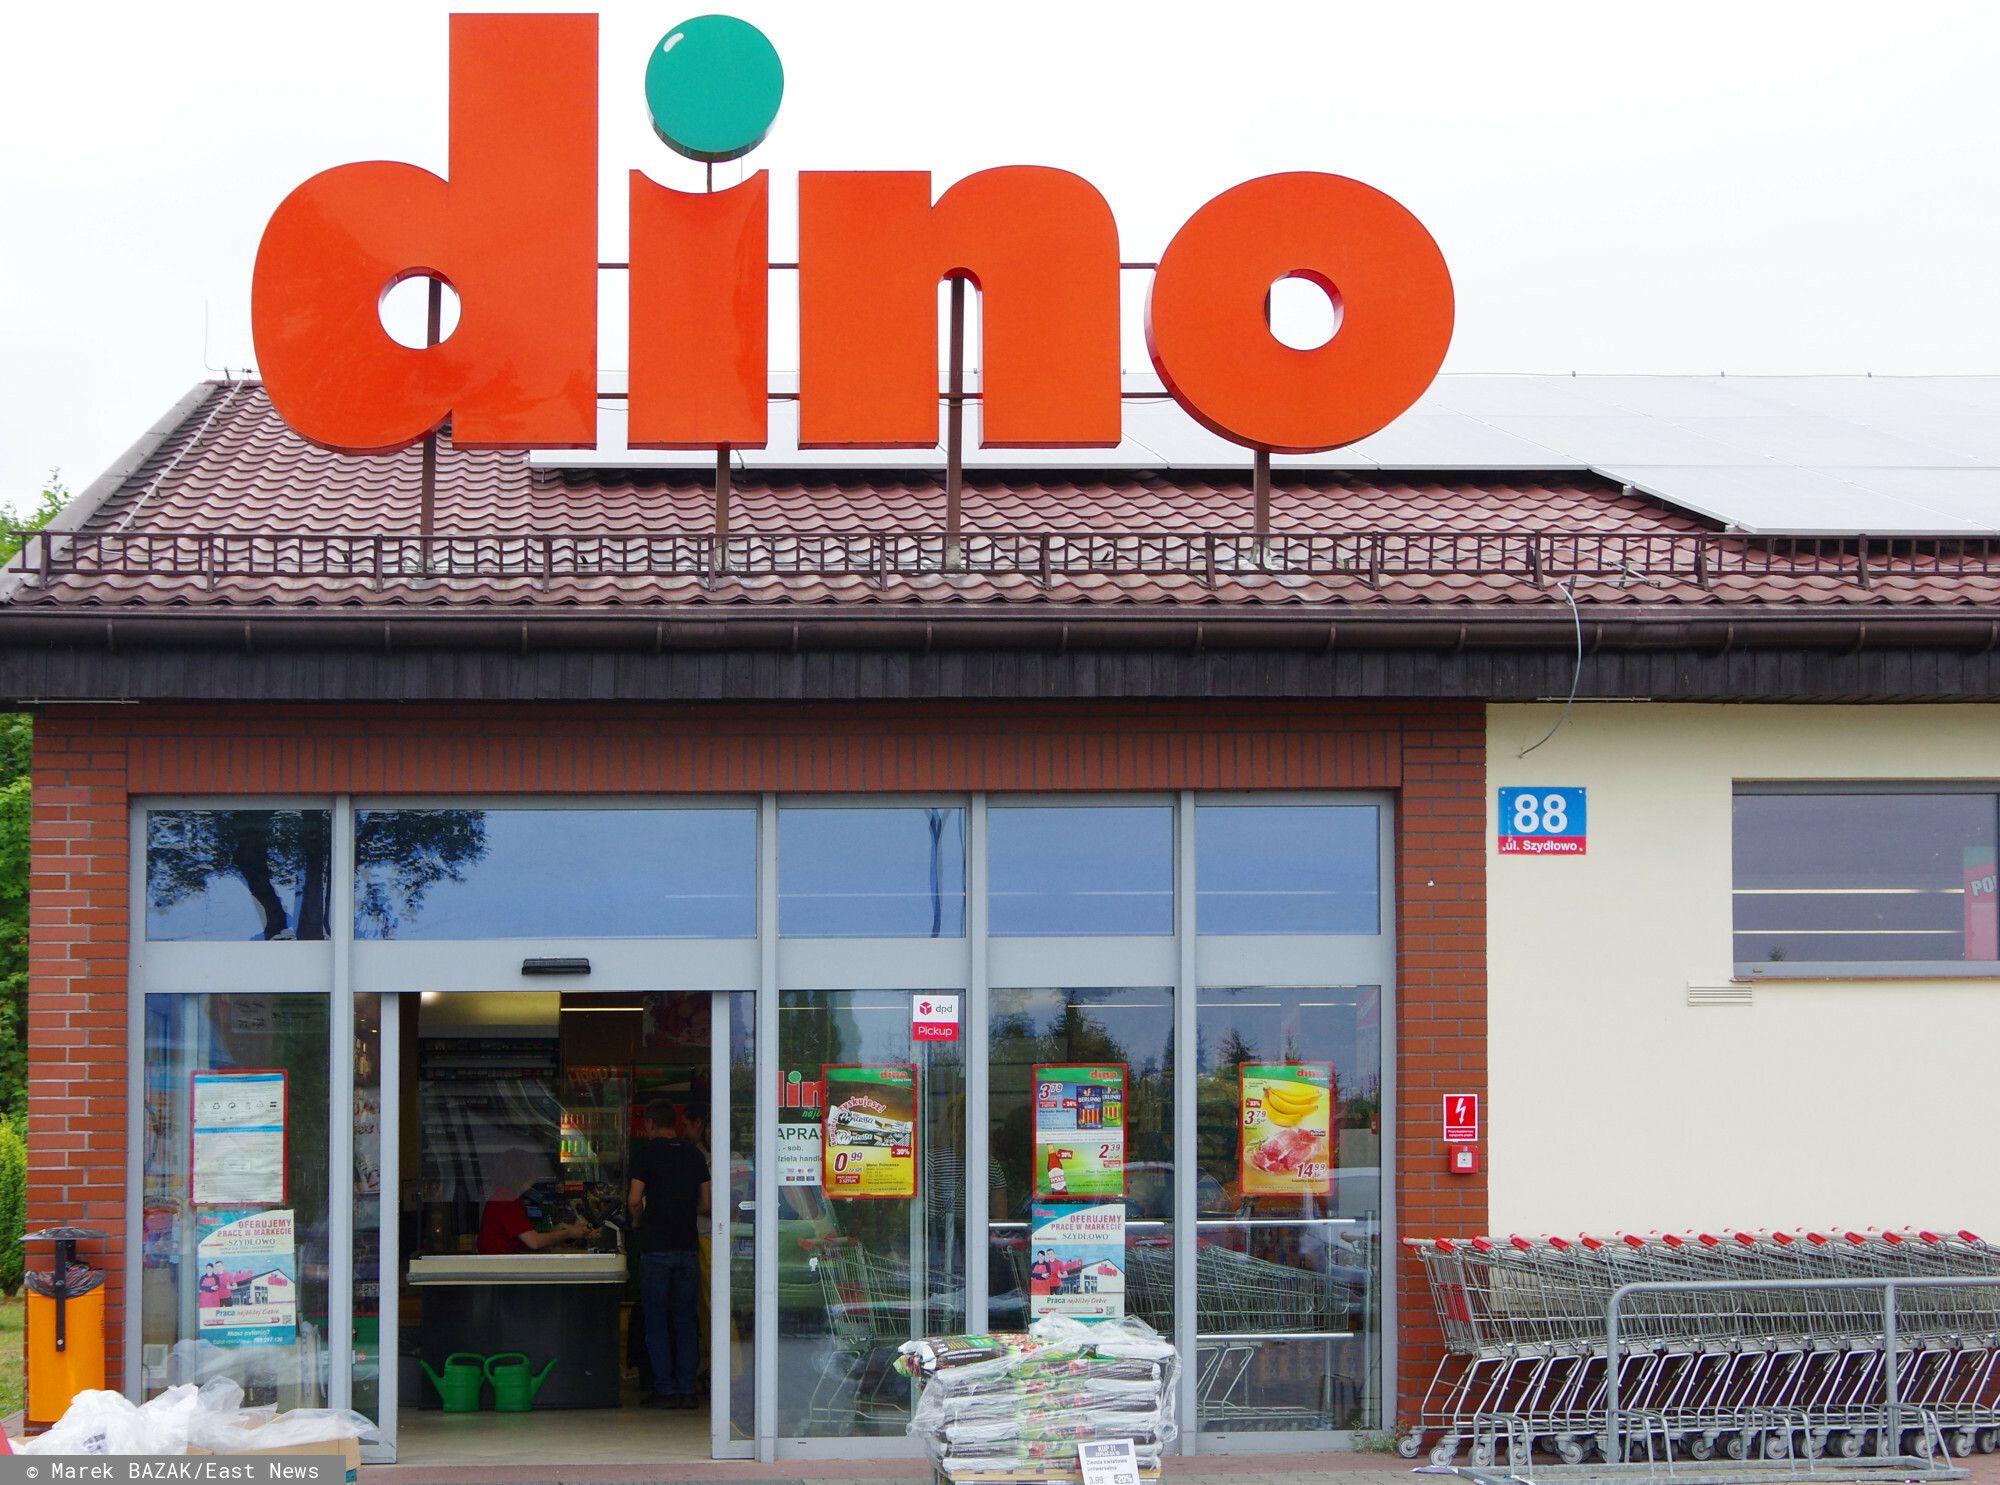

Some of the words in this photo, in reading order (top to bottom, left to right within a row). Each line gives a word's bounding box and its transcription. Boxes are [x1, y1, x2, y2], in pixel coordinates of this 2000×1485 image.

[251, 11, 1455, 454] dino
[1513, 793, 1568, 834] 88
[1505, 840, 1520, 851] ul.
[1522, 840, 1577, 853] Szydłowo
[935, 1005, 953, 1015] dpd
[917, 1026, 953, 1037] Pickup
[880, 1069, 909, 1080] dino
[1090, 1069, 1118, 1079] dino
[238, 1218, 292, 1229] OFERUJEMY
[1070, 1215, 1122, 1223] OFERUJEMY
[253, 1227, 292, 1237] MARKECIE
[1084, 1223, 1122, 1231] MARKECIE
[215, 1308, 236, 1318] Praca
